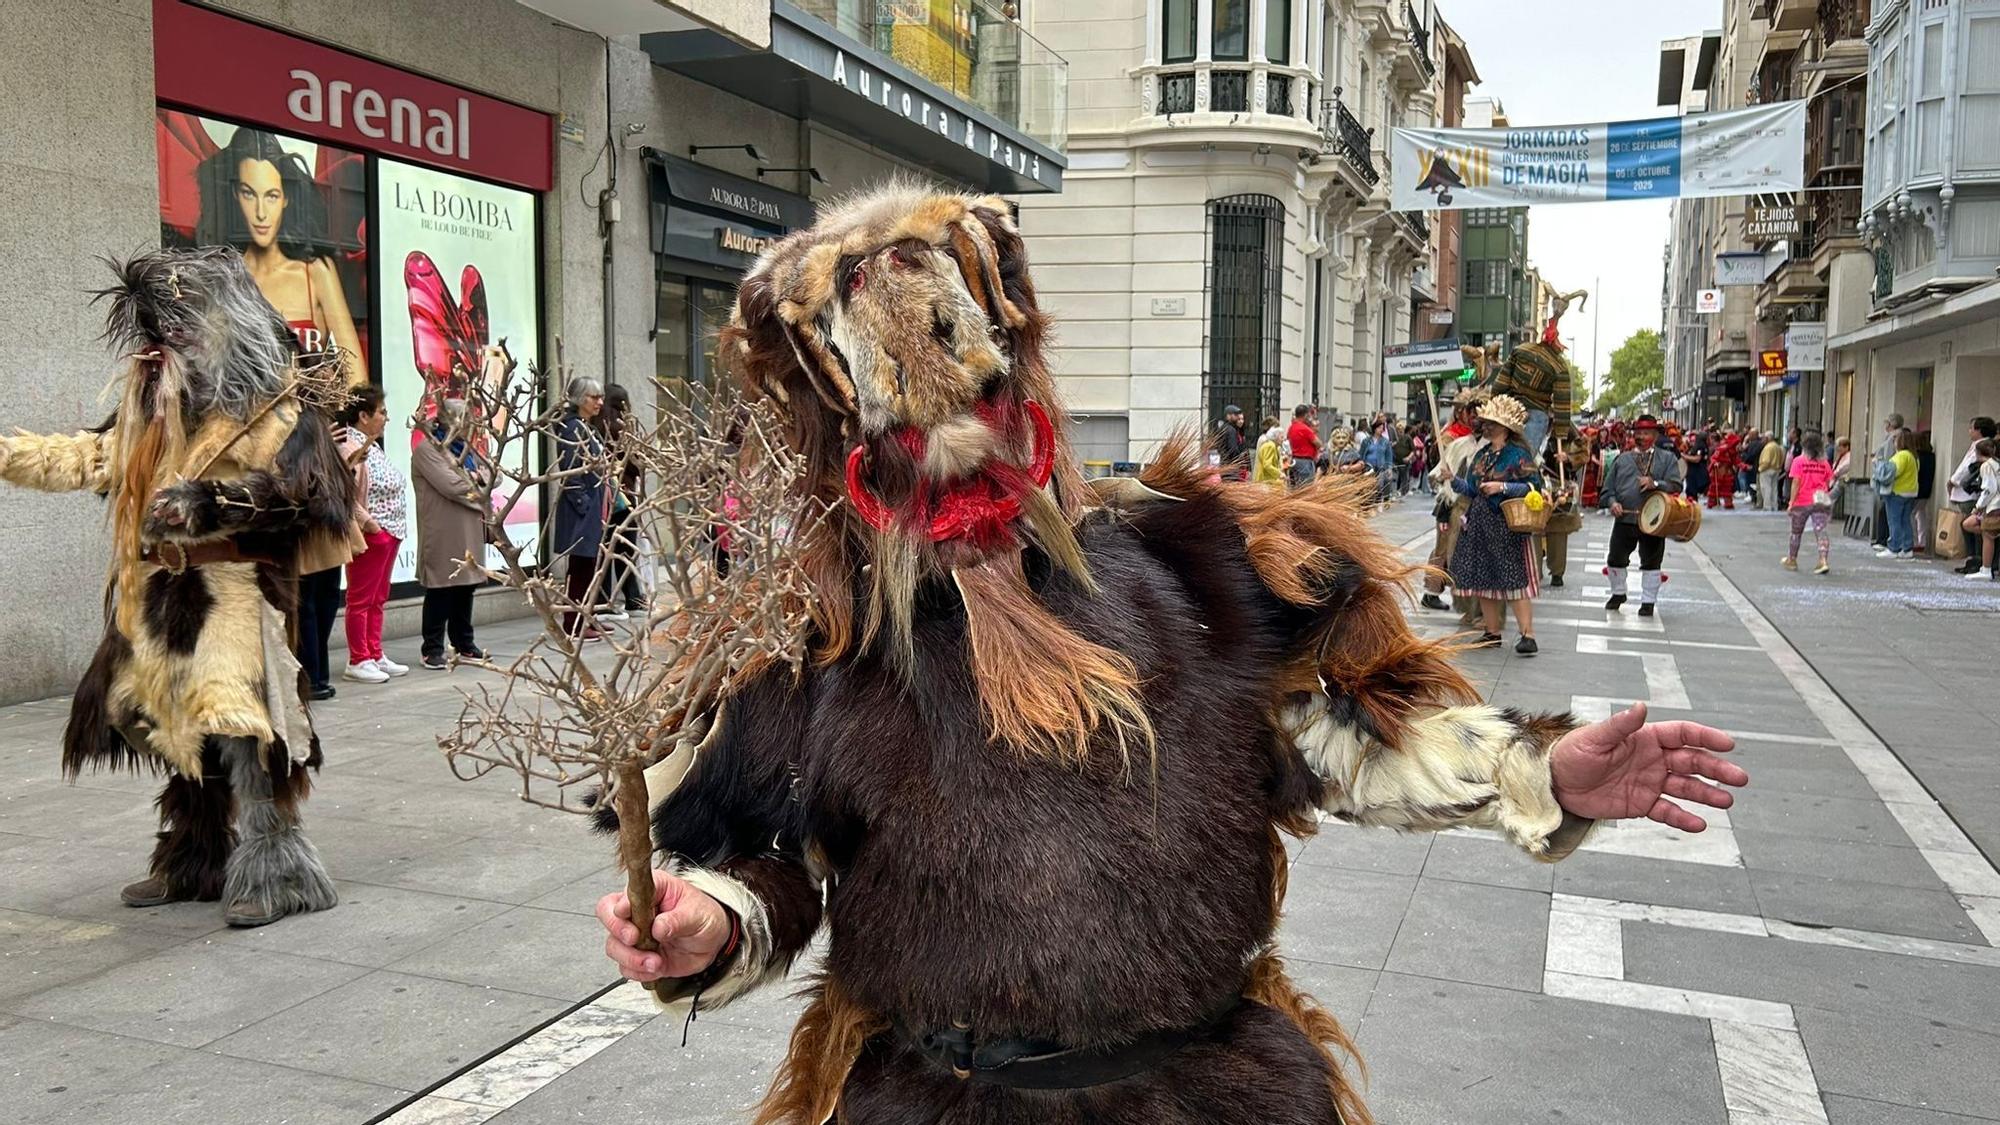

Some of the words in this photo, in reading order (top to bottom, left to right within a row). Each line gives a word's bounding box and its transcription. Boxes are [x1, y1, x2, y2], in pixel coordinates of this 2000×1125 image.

[287, 69, 470, 160] arenal
[832, 50, 948, 138] Aurora
[964, 120, 976, 150] &
[988, 132, 1040, 181] Payá
[1503, 128, 1589, 150] JORNADAS
[1632, 138, 1679, 152] SEPTIEMBRE
[1502, 149, 1589, 164] INTERNACIONALES
[1638, 153, 1649, 165] AL
[1503, 166, 1525, 185] DE
[1528, 163, 1589, 184] MAGIA
[1637, 165, 1672, 178] OCTUBRE
[1633, 180, 1654, 191] 2025
[395, 182, 427, 214] LA
[433, 190, 513, 232] BOMBA
[709, 187, 749, 211] AURORA
[1754, 207, 1795, 222] TEJIDOS
[421, 218, 433, 230] BE
[434, 220, 458, 235] LOUD
[459, 225, 471, 238] BE
[471, 228, 493, 241] FREE
[1748, 221, 1799, 235] CAXANDRA
[721, 226, 766, 254] Aurora
[1399, 359, 1423, 369] Carnaval
